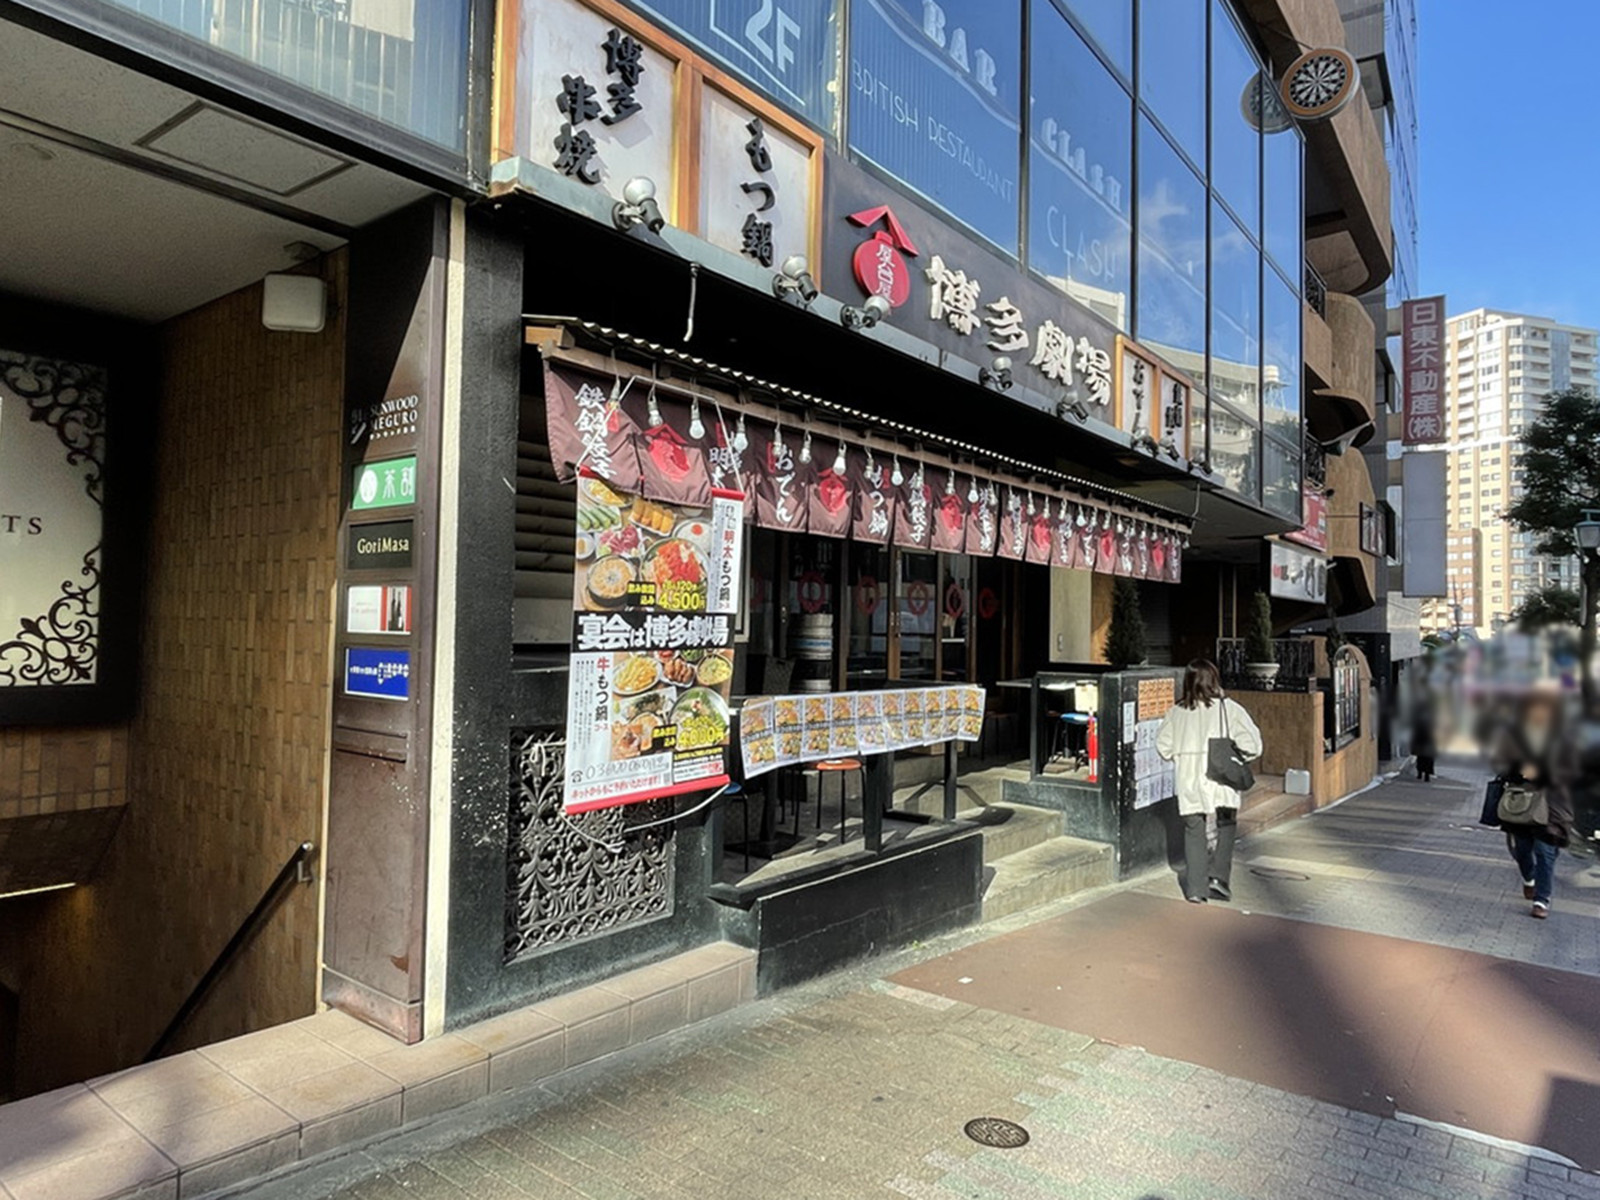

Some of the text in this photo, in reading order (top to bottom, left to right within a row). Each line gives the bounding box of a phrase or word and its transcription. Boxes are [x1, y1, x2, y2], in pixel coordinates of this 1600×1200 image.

[745, 0, 800, 73] 2F
[922, 0, 998, 97] BAR
[739, 117, 775, 268] もつ鍋
[925, 254, 1112, 406] 博多劇場
[1408, 302, 1443, 439] 日東不動産(株)
[357, 537, 410, 554] GoriMasa
[577, 613, 729, 650] 宴会は博多劇場
[595, 656, 610, 721] 牛もつ鍋
